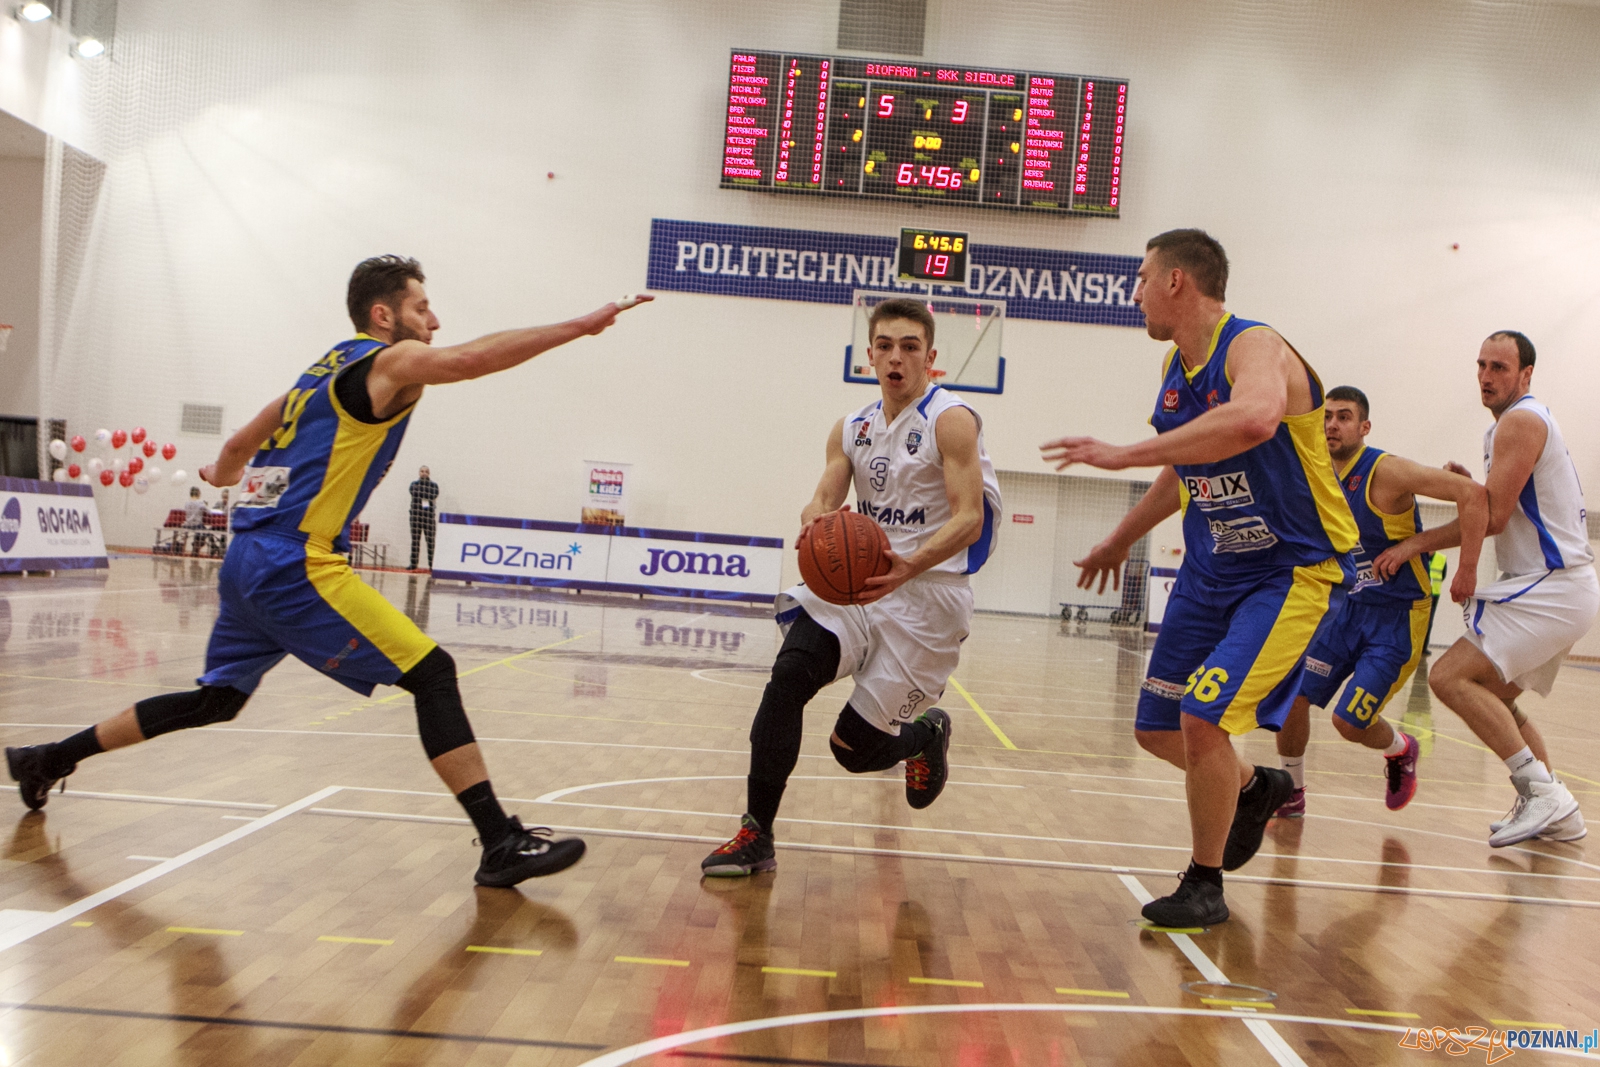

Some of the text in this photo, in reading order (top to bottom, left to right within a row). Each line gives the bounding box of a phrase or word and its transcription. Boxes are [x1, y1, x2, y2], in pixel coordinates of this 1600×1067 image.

[792, 59, 798, 67] 1
[732, 65, 755, 74] FISZER
[788, 69, 795, 77] 2
[866, 64, 917, 78] BIOFARM
[936, 69, 959, 82] SKK
[965, 72, 1016, 86] SIEDLCE
[788, 79, 794, 87] 3
[1031, 78, 1054, 86] SULIMA
[1087, 82, 1093, 90] 5
[786, 100, 793, 108] 6
[878, 95, 895, 117] 5
[785, 110, 792, 119] 8
[925, 108, 932, 121] 1
[952, 101, 968, 123] 3
[1085, 113, 1092, 121] 9
[782, 120, 792, 129] 10
[1083, 123, 1090, 131] 13
[852, 129, 862, 142] 2
[782, 141, 789, 149] 12
[914, 136, 942, 150] 0:00
[1081, 154, 1088, 162] 19
[780, 161, 788, 170] 16
[864, 160, 875, 173] 2
[1076, 164, 1087, 172] 25
[776, 171, 787, 180] 20
[969, 168, 980, 182] 0
[1076, 174, 1086, 182] 35
[1075, 185, 1086, 193] 66
[914, 235, 964, 252] 6.45.6
[924, 255, 949, 275] 19
[675, 240, 1143, 306] POLITECHNIK OZNAŃSK
[870, 456, 890, 492] 3
[1187, 474, 1248, 498] BOLIX
[37, 506, 92, 534] BIOFARM
[899, 689, 925, 719] 3
[1346, 686, 1378, 722] 15
